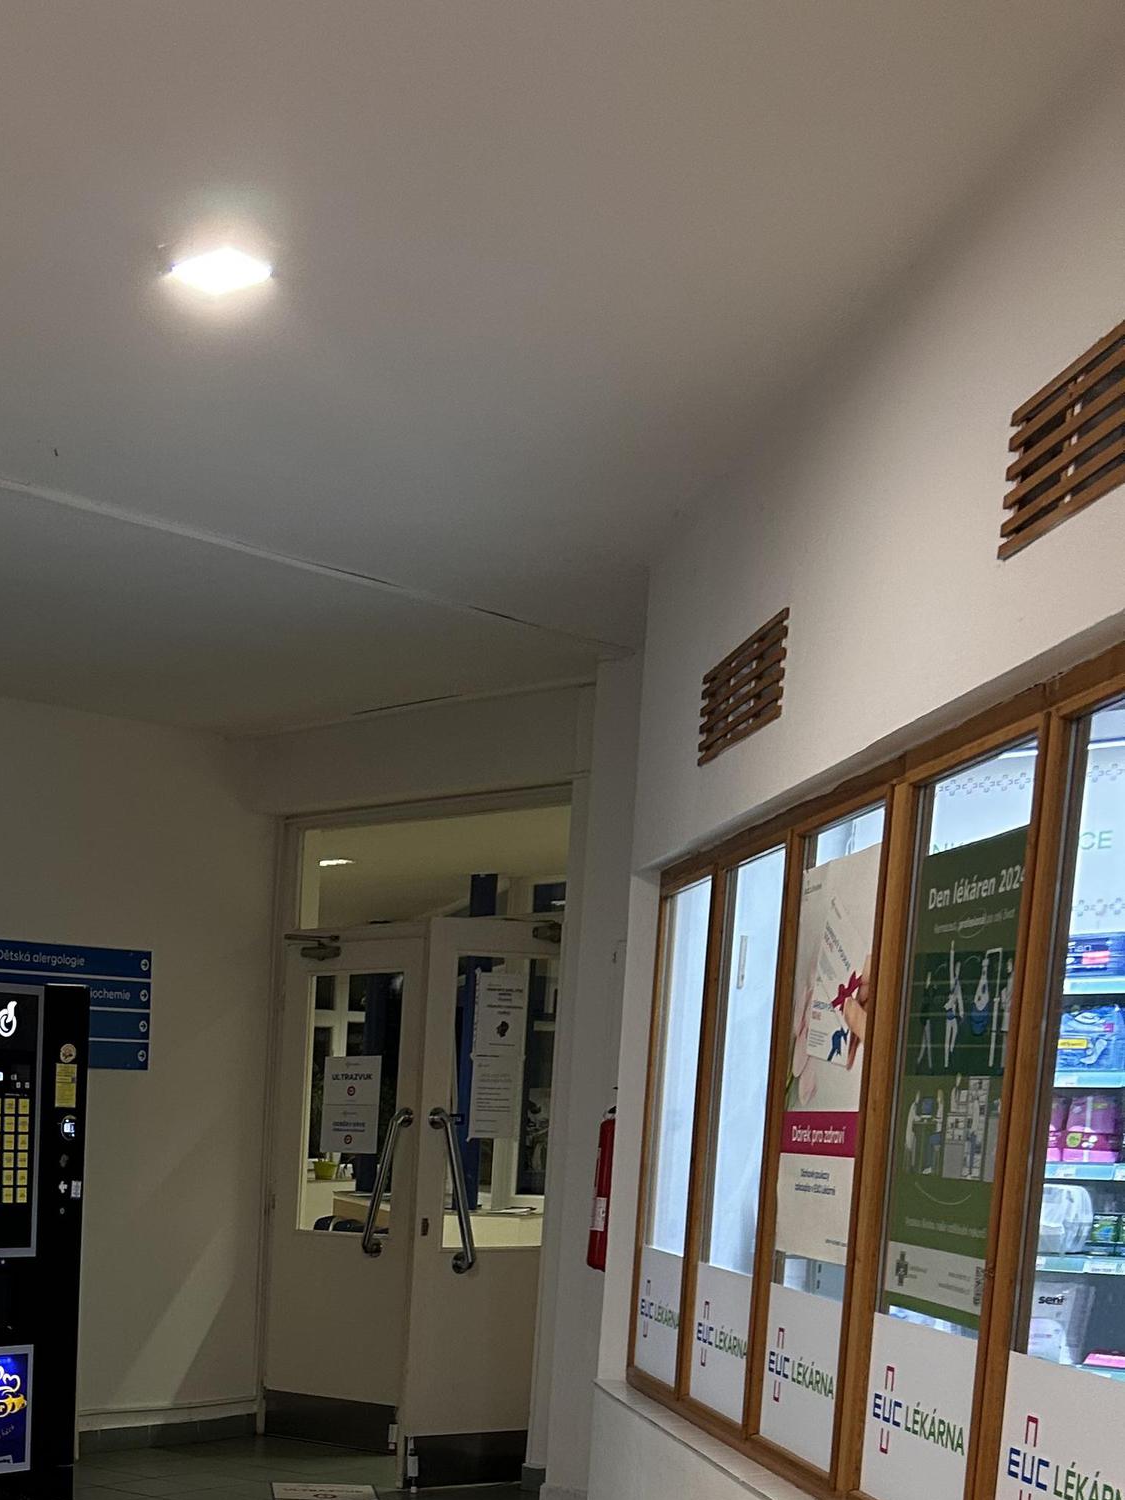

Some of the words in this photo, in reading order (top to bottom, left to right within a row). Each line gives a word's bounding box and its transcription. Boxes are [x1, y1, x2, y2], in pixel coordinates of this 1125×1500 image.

[928, 887, 951, 910] Den
[952, 874, 997, 905] lékáren
[32, 953, 86, 967] alergologie
[90, 988, 131, 1000] iochemie
[331, 1073, 373, 1081] ULTRAZVUK
[791, 1125, 811, 1142] Dárek
[812, 1129, 824, 1146] pro
[824, 1125, 847, 1144] zdraví
[1038, 1294, 1064, 1306] seni
[791, 1356, 835, 1400] LÉKÁRNA
[904, 1402, 965, 1456] LÉKÁRNA
